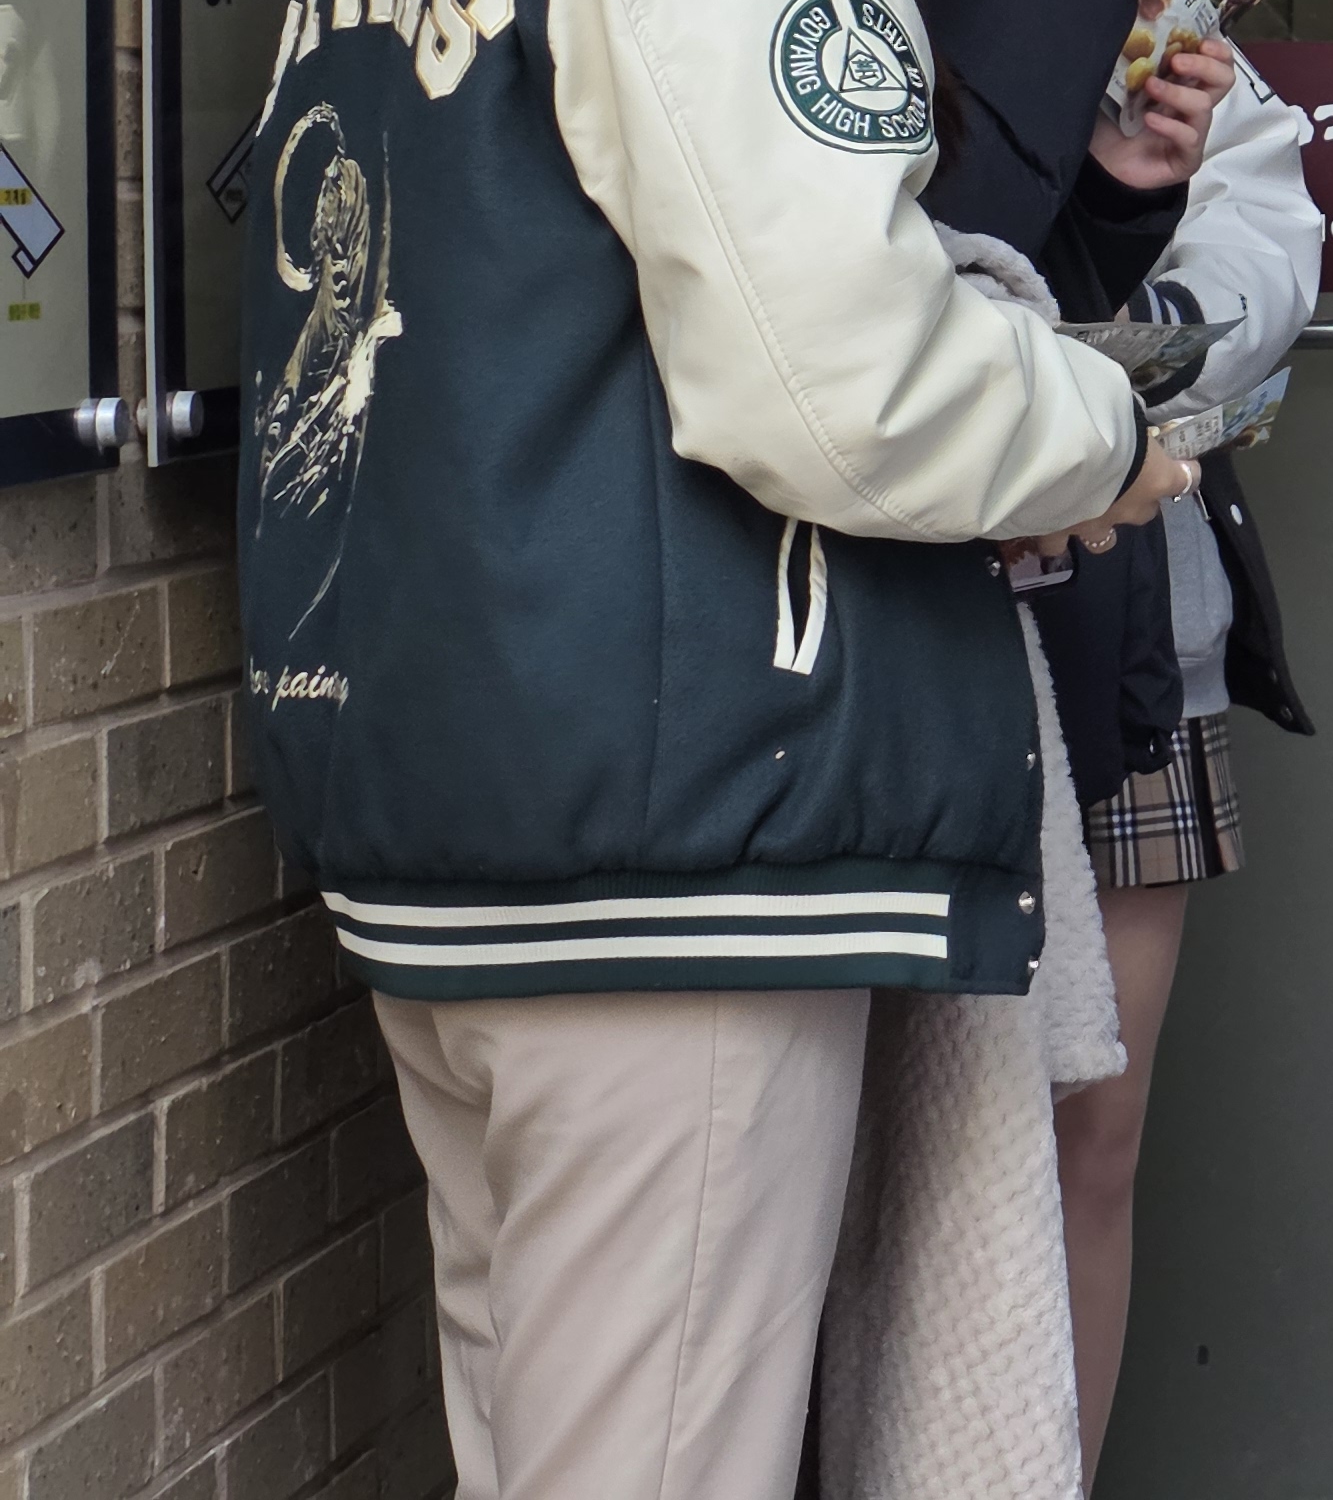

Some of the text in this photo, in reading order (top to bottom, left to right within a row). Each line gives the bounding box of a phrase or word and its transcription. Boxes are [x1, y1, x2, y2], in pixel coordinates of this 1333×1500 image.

[790, 6, 831, 95] GOYANG
[861, 3, 907, 53] ARTS
[812, 95, 870, 137] HIGH
[878, 92, 926, 138] SCHOOL
